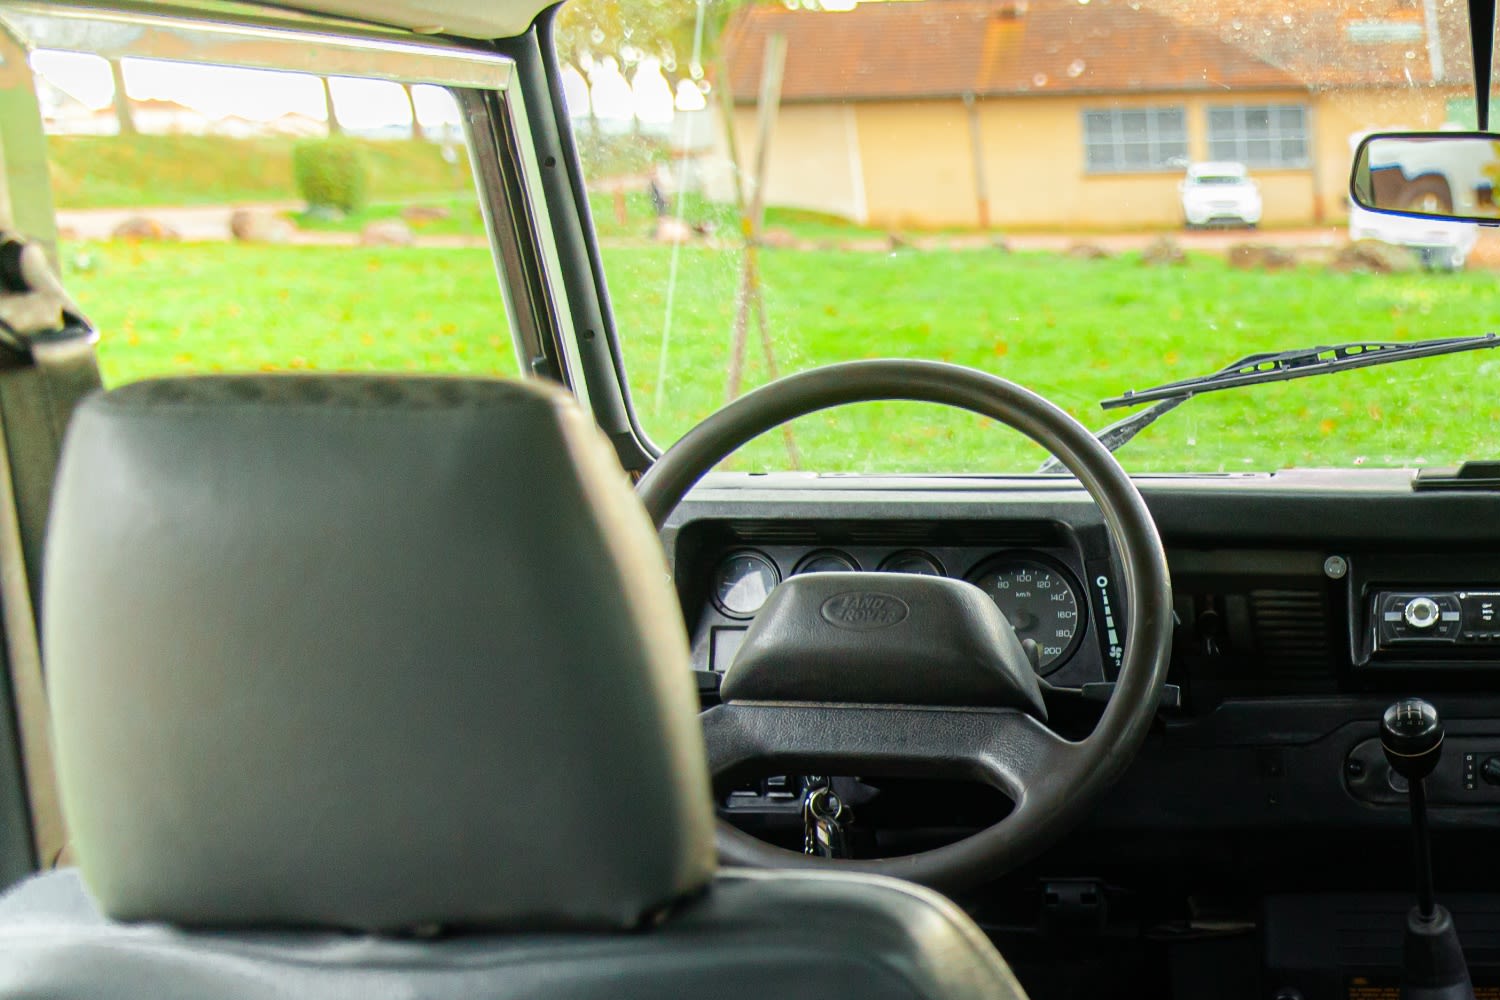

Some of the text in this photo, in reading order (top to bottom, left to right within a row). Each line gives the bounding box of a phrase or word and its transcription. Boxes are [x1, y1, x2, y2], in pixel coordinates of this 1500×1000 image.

[997, 581, 1009, 589] 80
[1036, 581, 1051, 589] 120
[1044, 647, 1062, 655] 200
